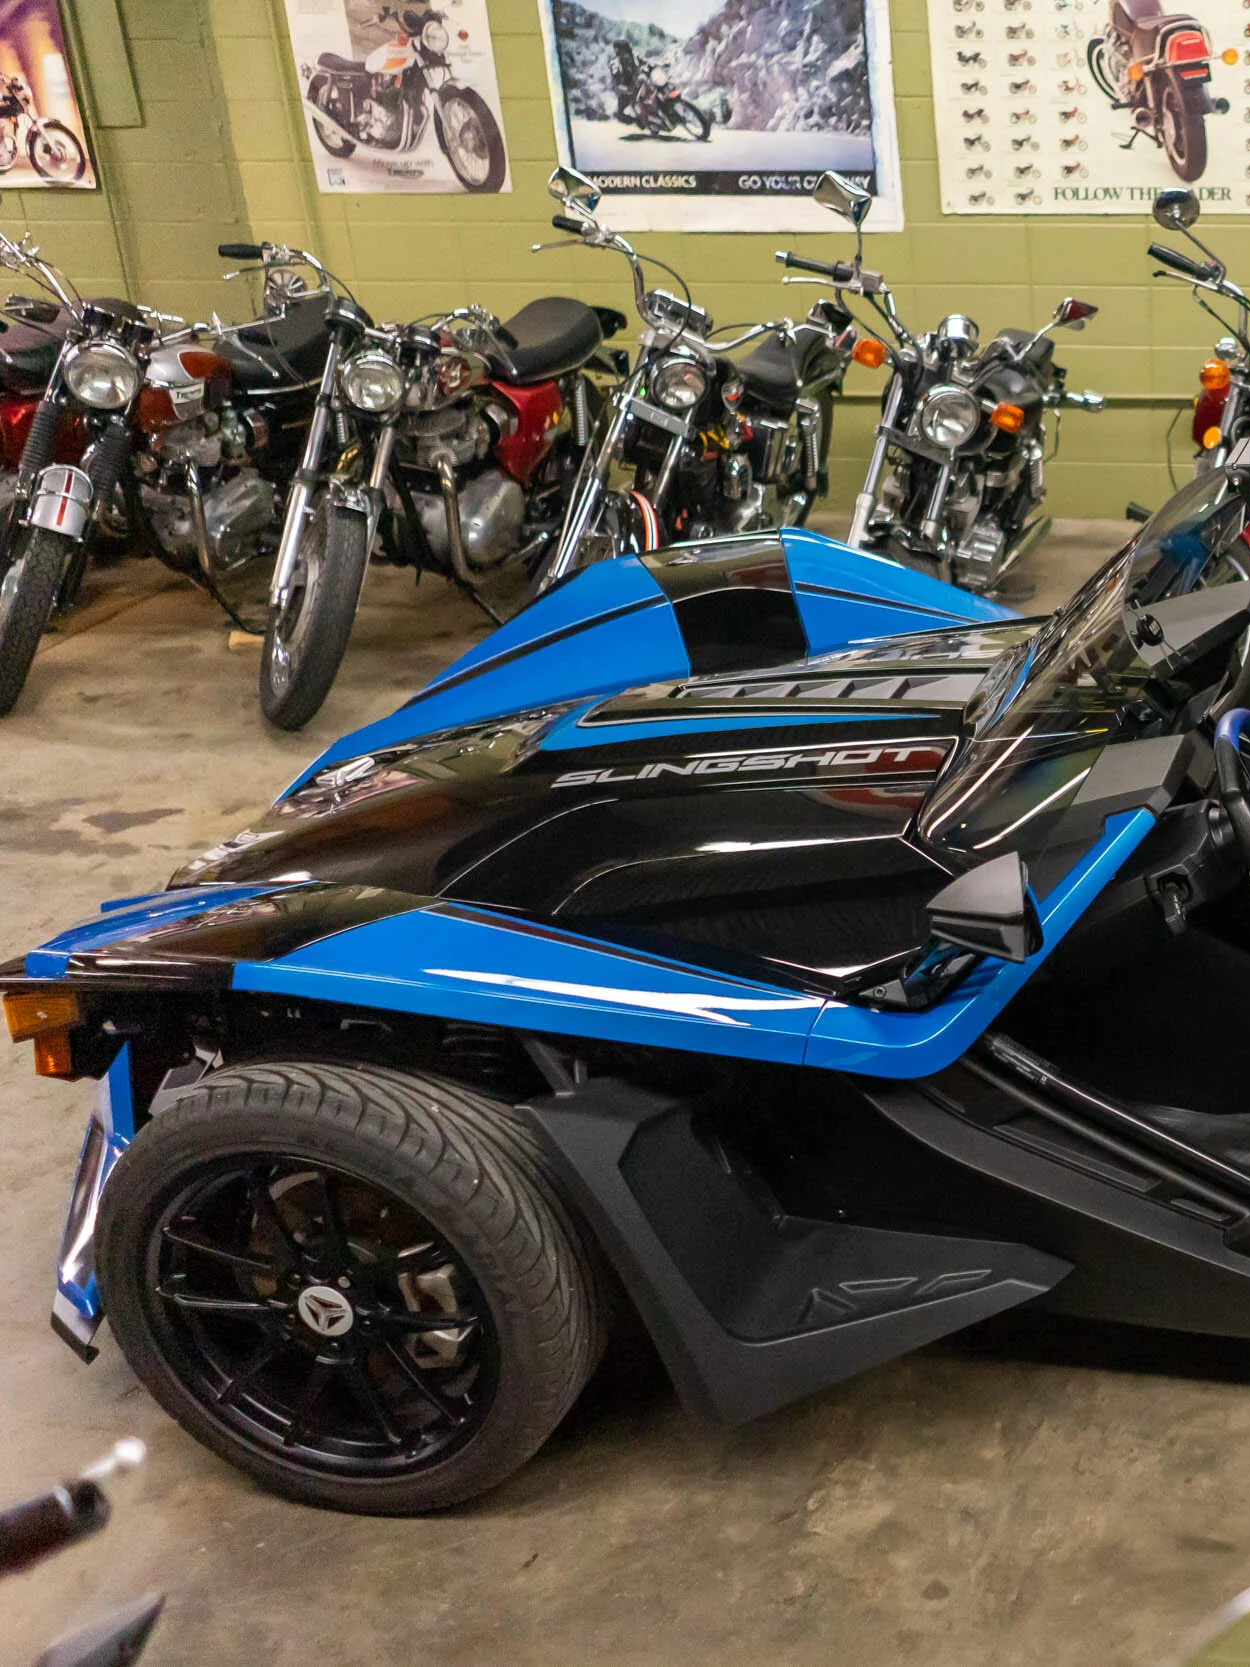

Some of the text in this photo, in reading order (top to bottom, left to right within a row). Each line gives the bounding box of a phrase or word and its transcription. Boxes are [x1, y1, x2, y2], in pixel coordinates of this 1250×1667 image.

[641, 175, 697, 188] CLASSICS
[738, 175, 762, 190] GO
[763, 175, 801, 190] YOUR
[1053, 186, 1122, 201] FOLLOW
[550, 746, 932, 788] SLINGSHOT
